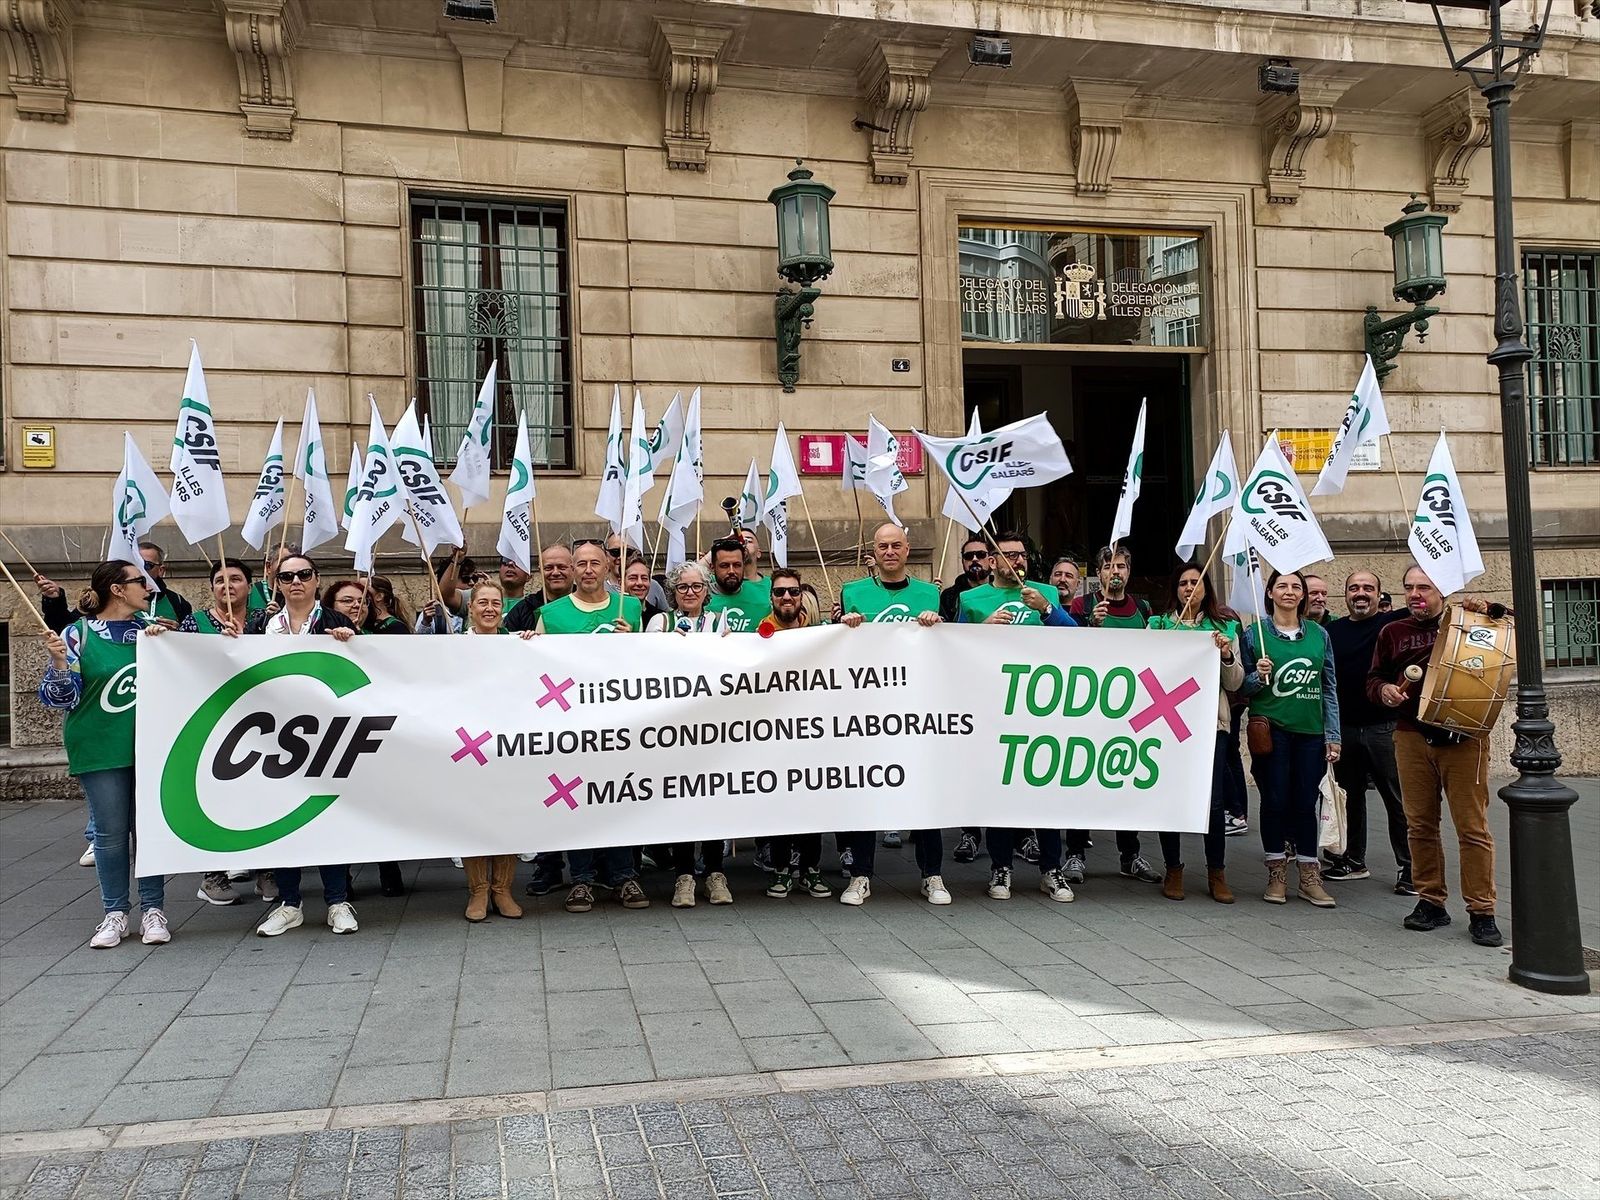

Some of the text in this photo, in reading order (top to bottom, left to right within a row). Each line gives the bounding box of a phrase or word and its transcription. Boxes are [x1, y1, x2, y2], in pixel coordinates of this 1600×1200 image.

[964, 290, 1047, 302] GOVERN A LES
[1025, 280, 1047, 290] DEL
[1111, 282, 1181, 294] DELEGACIÓN
[1111, 294, 1186, 306] GOBIERNO EN
[963, 302, 1048, 315] ILLES BALEARS
[1112, 307, 1193, 318] ILLES BALEARS
[897, 360, 904, 370] 4
[185, 415, 222, 471] CSIF
[960, 440, 1014, 472] CSIF
[180, 465, 204, 497] ILLES
[400, 460, 447, 506] CSIF
[990, 467, 1036, 480] BALEARS
[1256, 480, 1308, 522] CSIF
[505, 510, 529, 542] ALEARS
[1250, 517, 1279, 548] BALEARS
[1266, 518, 1289, 541] ILLES
[1429, 527, 1454, 553] ILLES
[1413, 526, 1442, 560] BALEARS
[719, 668, 842, 696] SALARIAL
[848, 666, 907, 689] YA!!!
[1001, 664, 1136, 719] TODO
[1283, 669, 1319, 684] CSIF
[211, 711, 398, 781] CSIF
[497, 713, 974, 758] MEJORES CONDICIONES LABORALES
[999, 735, 1162, 790] TOD@S
[587, 764, 906, 805] MÁS EMPLEO PUBLICO
